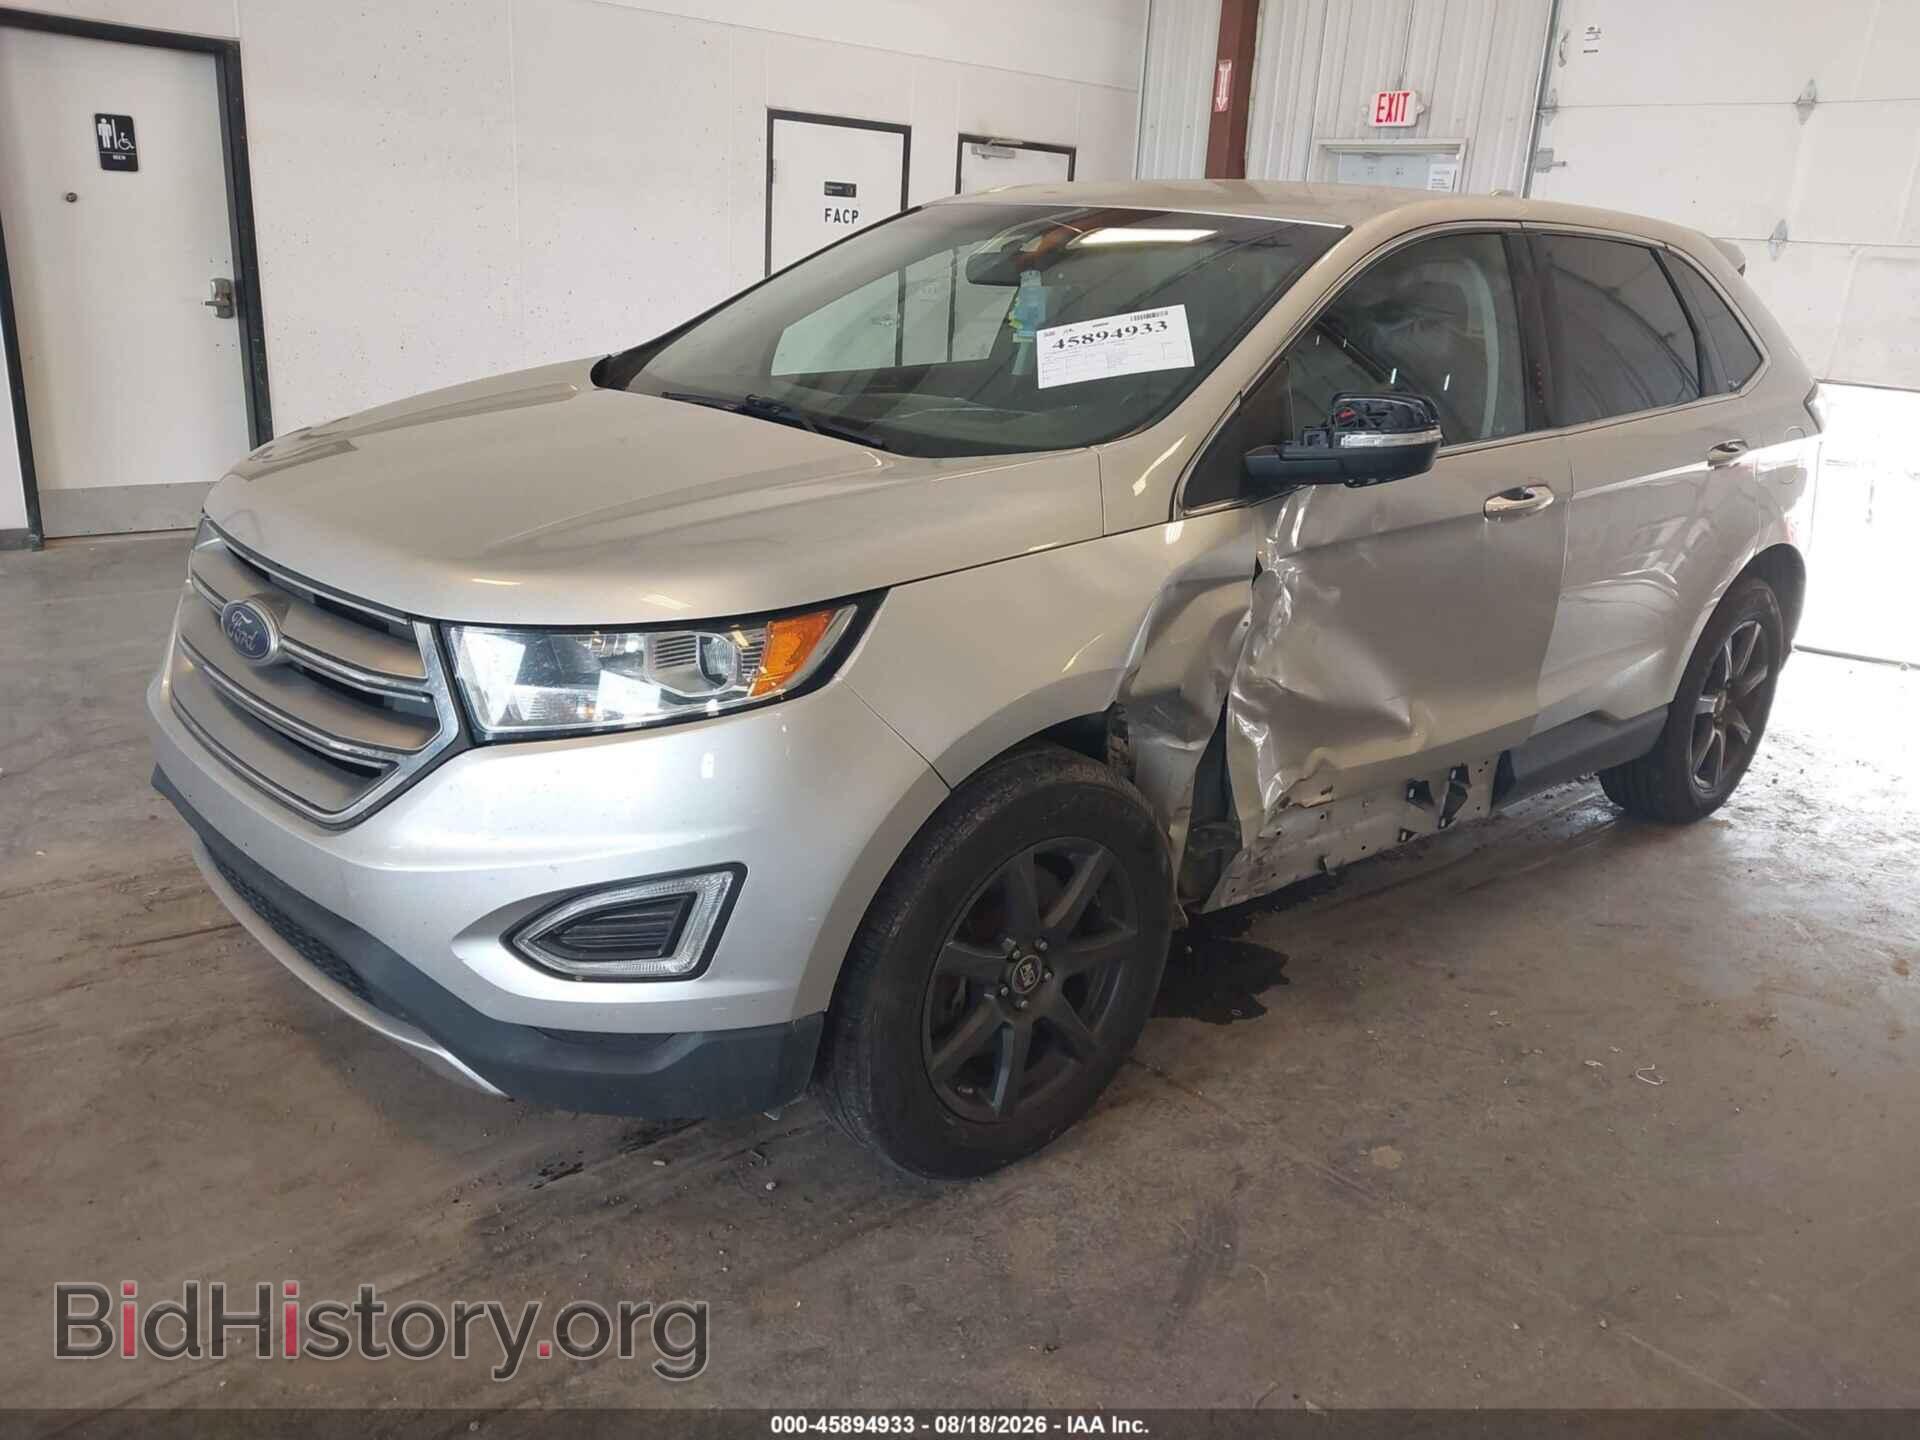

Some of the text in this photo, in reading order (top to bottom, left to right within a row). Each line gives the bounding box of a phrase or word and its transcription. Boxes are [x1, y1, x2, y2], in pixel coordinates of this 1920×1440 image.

[1376, 92, 1410, 123] EXIT
[824, 208, 859, 224] FACP
[1052, 320, 1168, 349] 45894933
